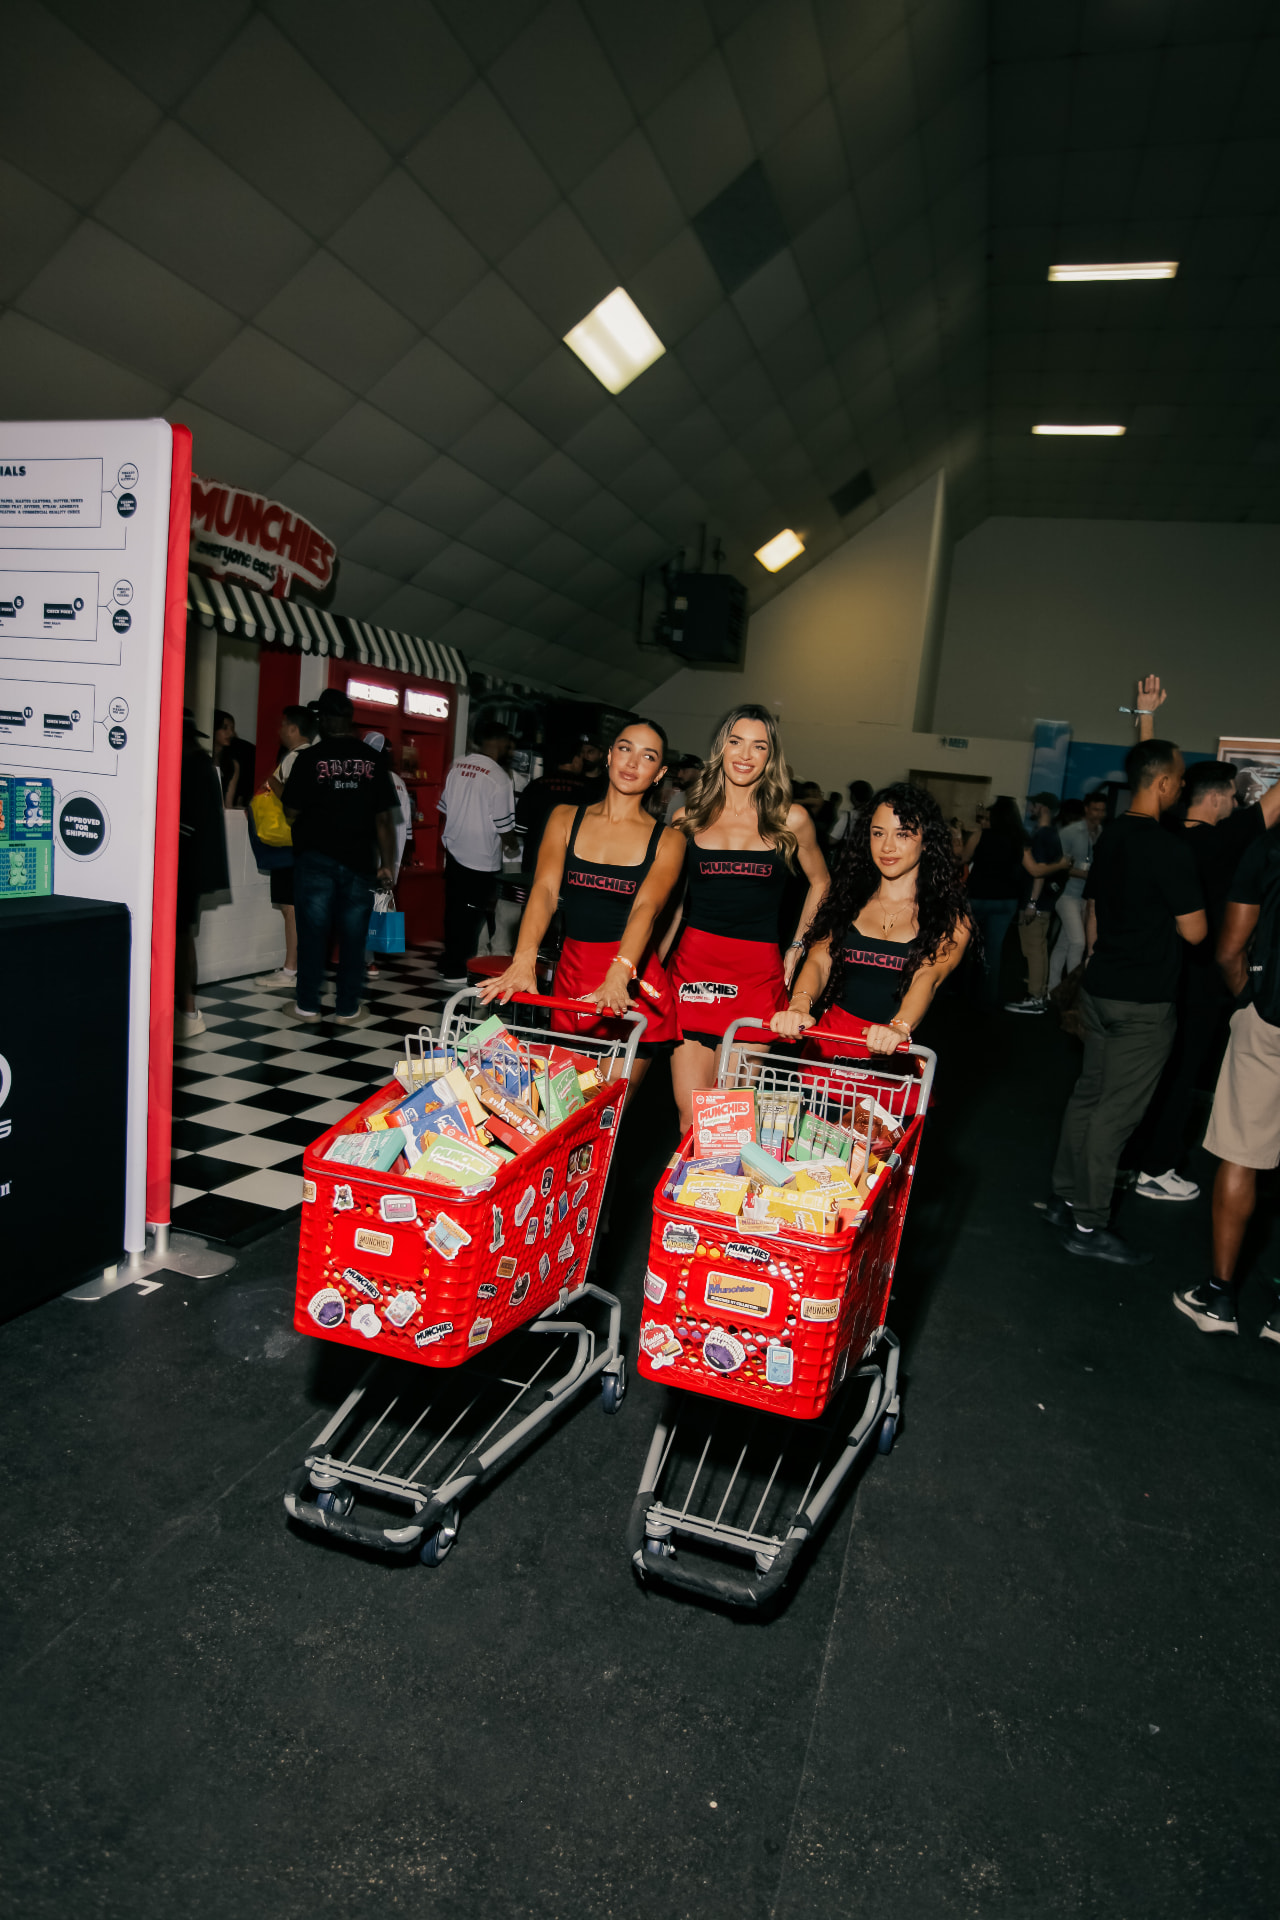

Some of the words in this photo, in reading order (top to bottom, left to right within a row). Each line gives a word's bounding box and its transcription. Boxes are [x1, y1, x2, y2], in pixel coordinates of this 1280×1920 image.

[191, 477, 333, 584] MUNCHIES
[196, 541, 252, 568] everyone
[252, 558, 278, 580] eats
[316, 759, 376, 782] ABCDE
[461, 771, 477, 779] EATS
[64, 815, 101, 826] APPROVED
[65, 829, 99, 839] SHIPPING
[700, 862, 772, 877] MUNCHIES
[568, 870, 636, 894] MUNCHIES
[680, 982, 737, 997] MUNCHIES
[699, 1103, 749, 1121] MUNCHIES
[467, 1140, 487, 1154] OUNCE
[485, 1150, 501, 1163] PACK
[359, 1235, 390, 1250] MUNCHIES
[727, 1243, 769, 1260] MUNCHIES
[346, 1268, 379, 1298] MUNCHIES
[708, 1283, 755, 1295] Munchies
[806, 1304, 837, 1315] MUNCHIES
[416, 1322, 453, 1341] MUNCHIES
